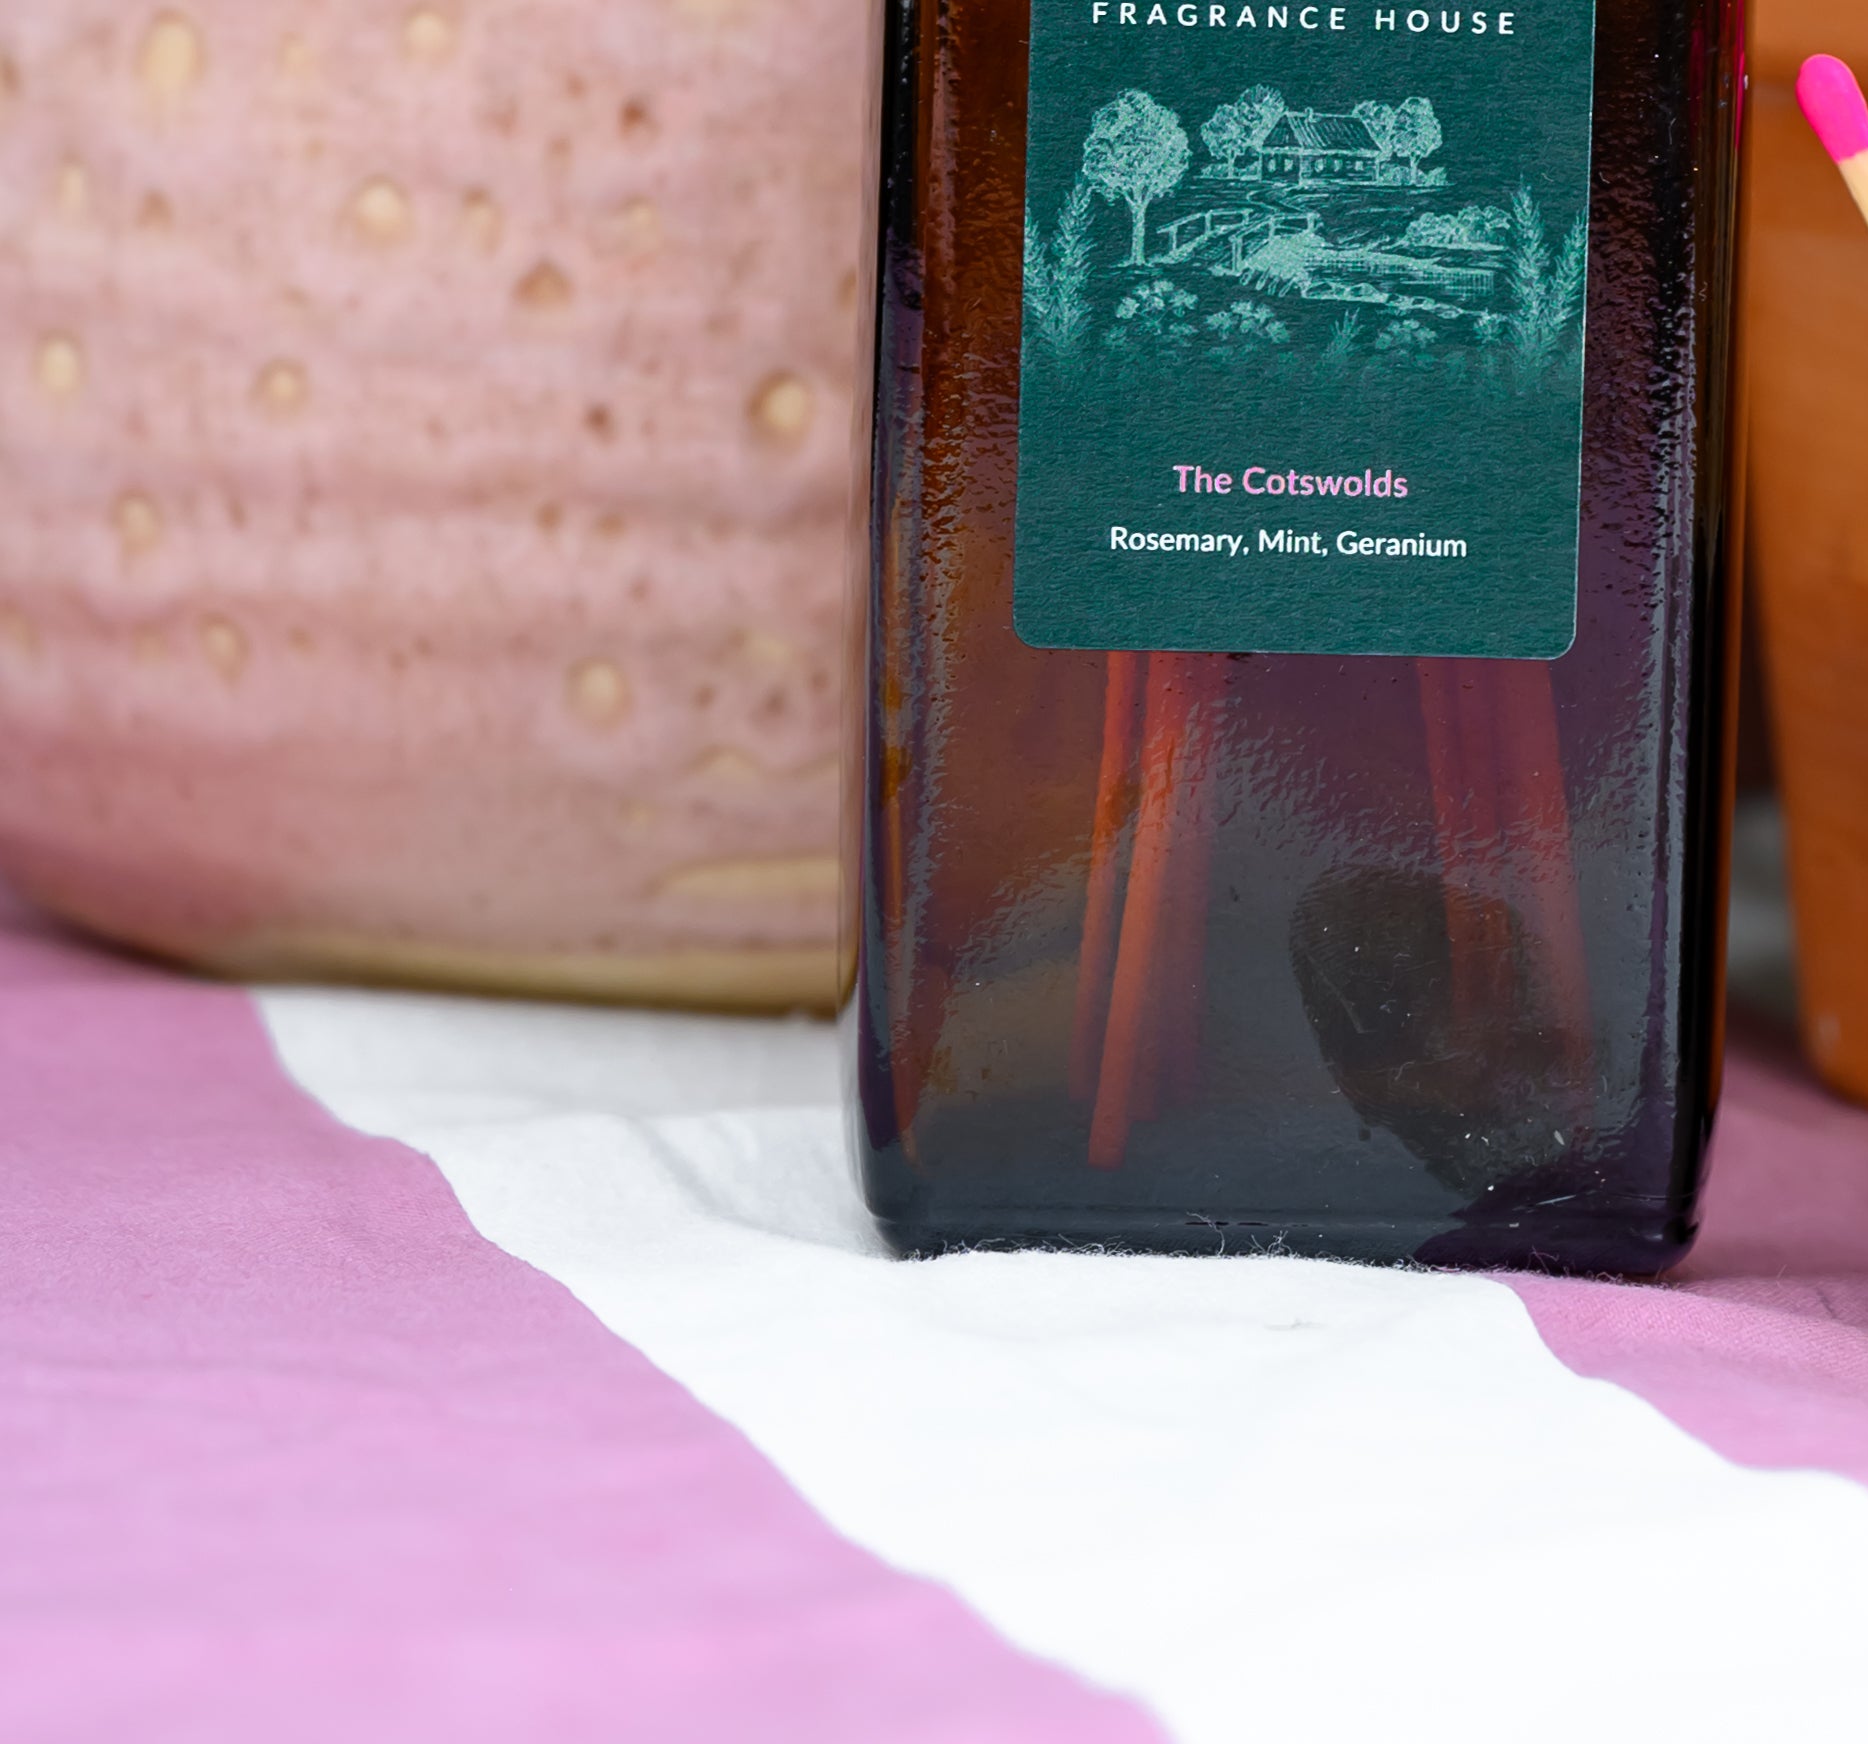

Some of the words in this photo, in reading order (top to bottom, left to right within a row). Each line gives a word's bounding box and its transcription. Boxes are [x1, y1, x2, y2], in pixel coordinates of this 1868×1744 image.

[1092, 1, 1347, 30] FRAGRANCE
[1375, 9, 1515, 35] HOUSE
[1172, 465, 1234, 494] The
[1242, 466, 1409, 498] Cotswolds
[1110, 526, 1249, 557] Rosemary,
[1258, 529, 1328, 557] Mint,
[1336, 530, 1468, 558] Geranium
